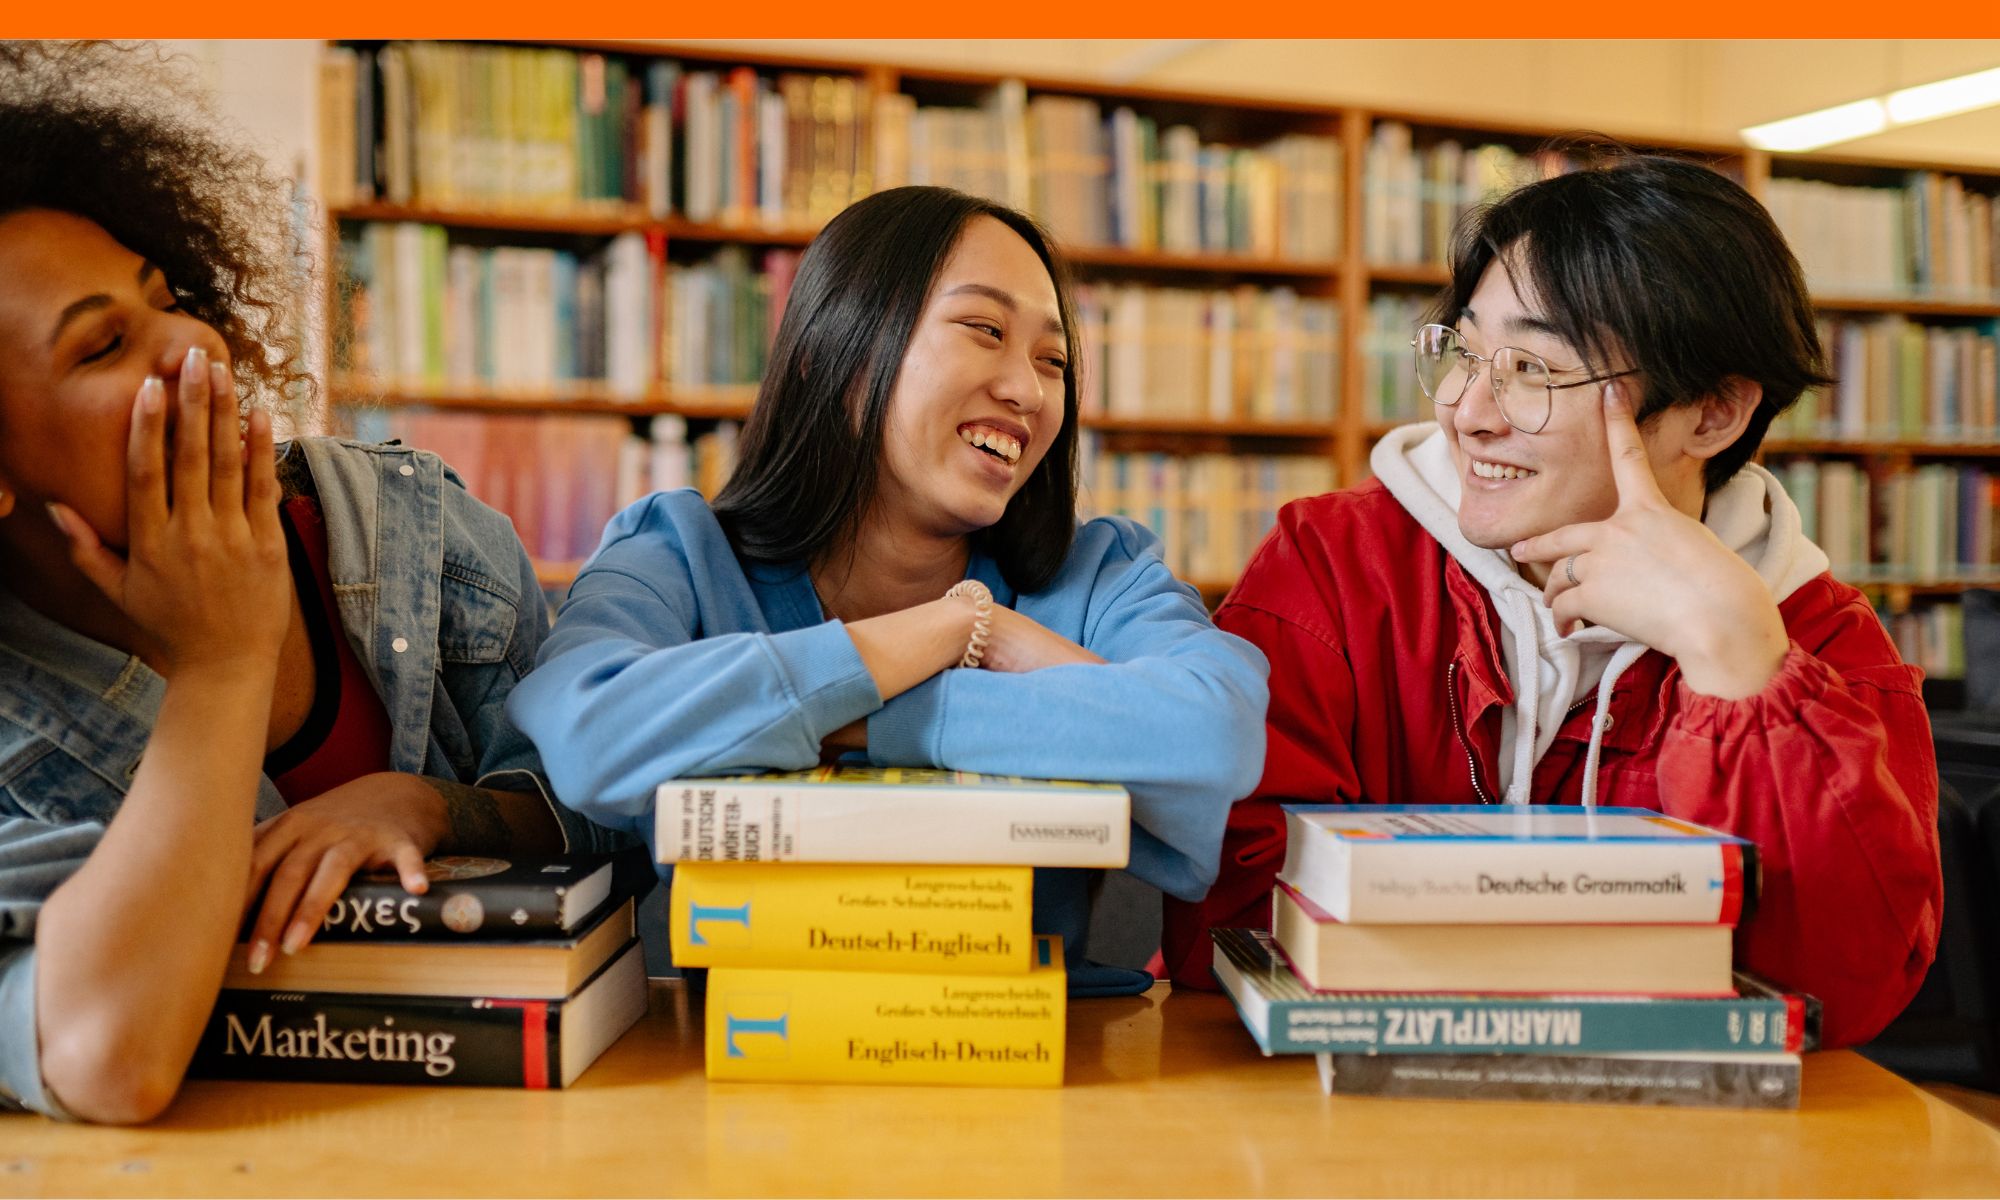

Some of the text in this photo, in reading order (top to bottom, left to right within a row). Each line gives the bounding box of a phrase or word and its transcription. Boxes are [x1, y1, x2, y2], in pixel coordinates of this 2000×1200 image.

[699, 789, 716, 861] DEUTSCHE
[744, 823, 760, 862] BUCH
[1476, 873, 1568, 895] Deutsche
[1573, 873, 1687, 895] Grammatik
[808, 927, 1011, 960] Deutsch-Englisch
[223, 1012, 456, 1077] Marketing
[1384, 1008, 1582, 1045] MARKTPLATZ
[848, 1038, 1050, 1068] Englisch-Deutsch
